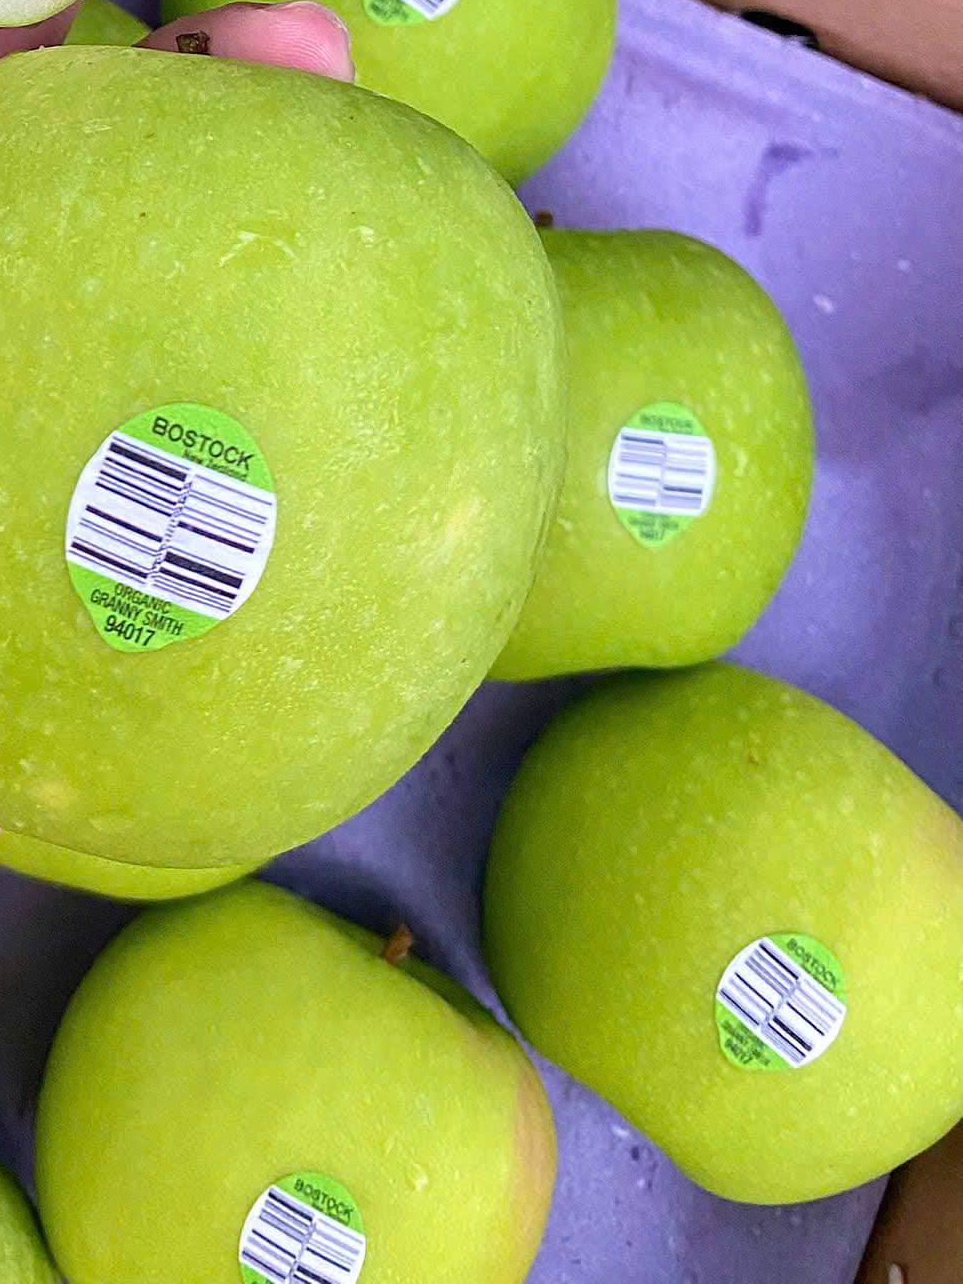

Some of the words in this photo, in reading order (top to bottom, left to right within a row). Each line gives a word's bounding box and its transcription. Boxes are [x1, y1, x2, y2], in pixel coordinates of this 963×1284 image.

[152, 416, 254, 471] BOSTOCK
[90, 588, 142, 619] GRANNY
[142, 610, 185, 637] SMITH
[114, 582, 172, 616] ORGANIC
[103, 614, 156, 647] 94017
[294, 1178, 354, 1224] BOSTOCK
